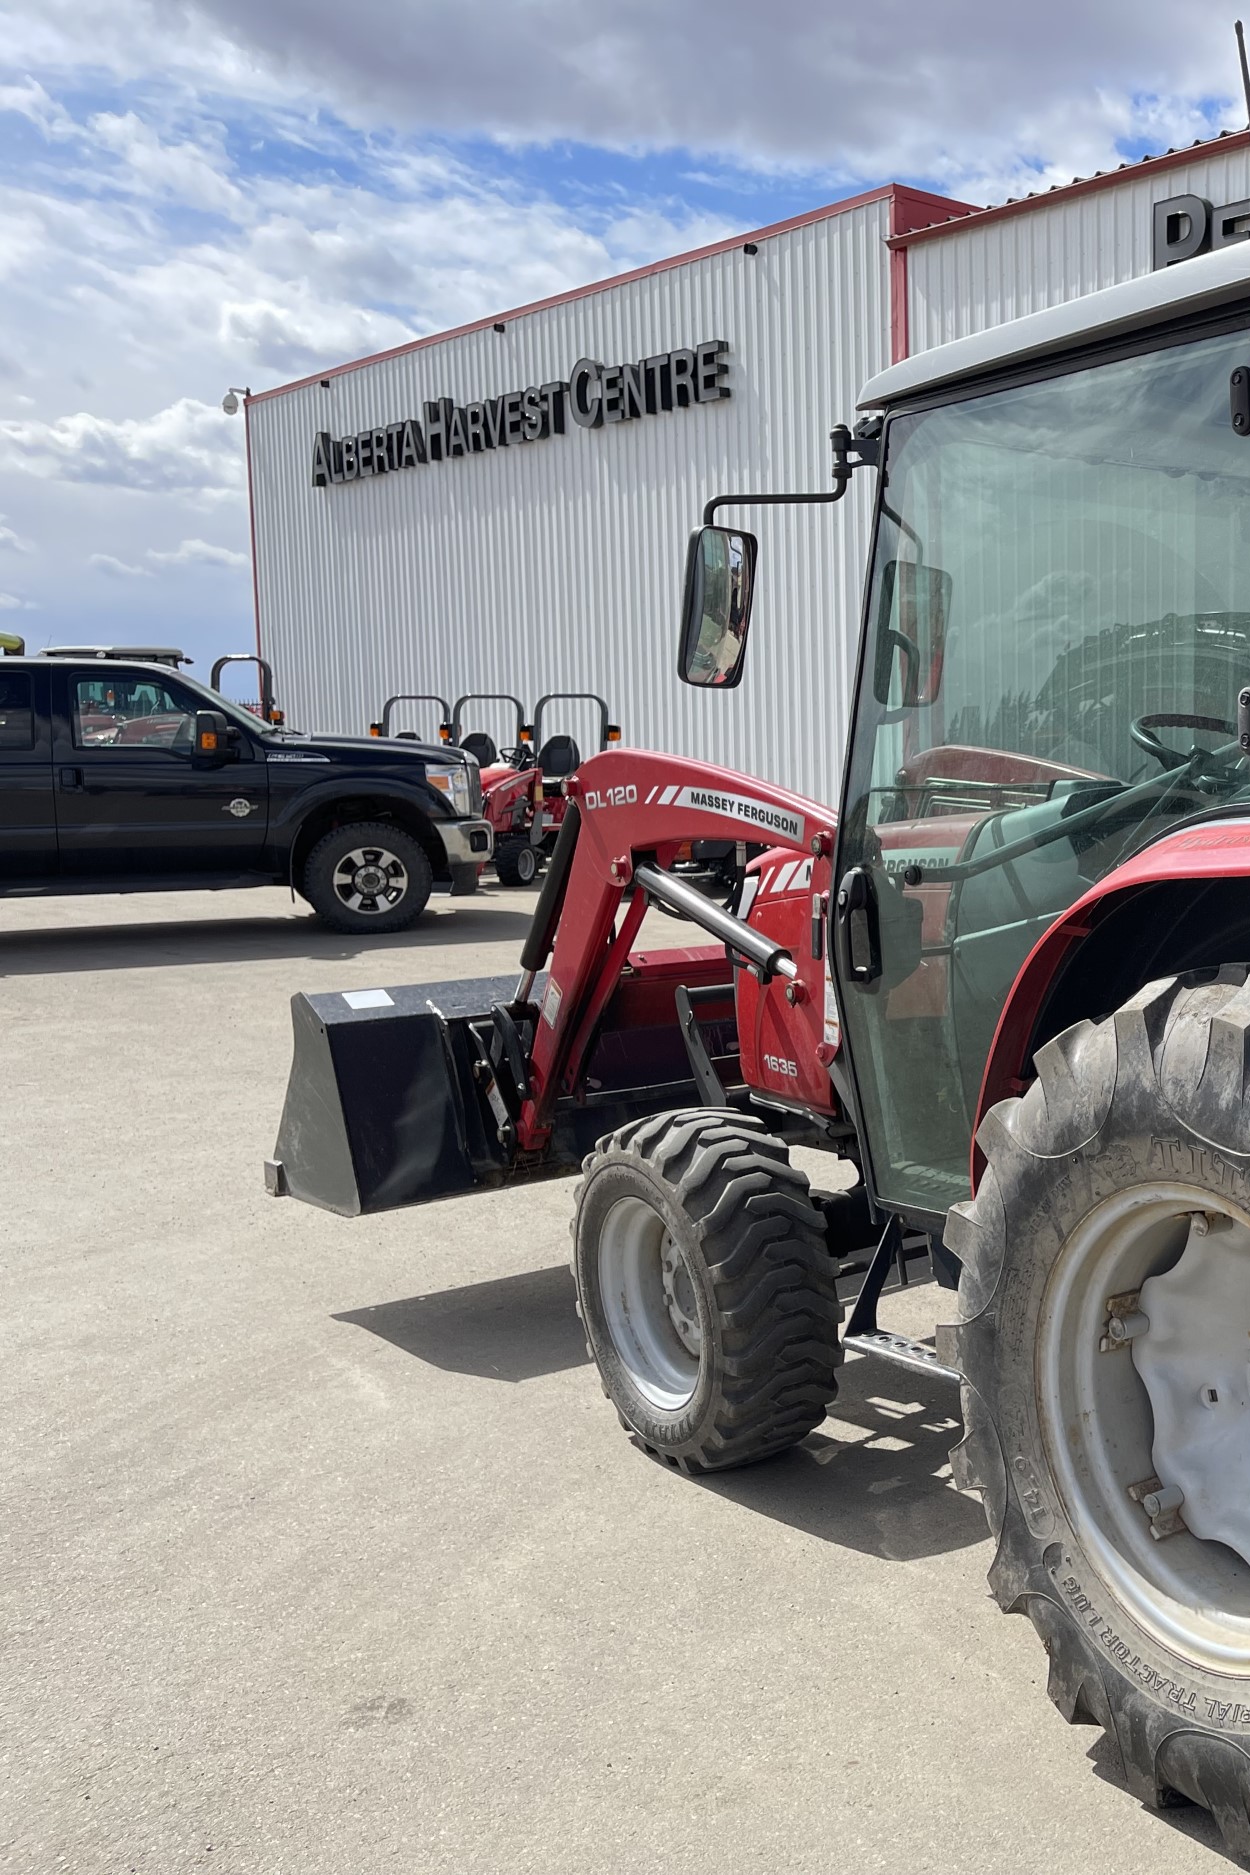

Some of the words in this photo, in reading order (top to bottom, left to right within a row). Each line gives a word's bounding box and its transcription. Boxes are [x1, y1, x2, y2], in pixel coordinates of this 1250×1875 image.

[312, 419, 428, 487] ALBERTA
[423, 380, 571, 463] HARVEST
[569, 339, 731, 429] CENTRE
[585, 784, 638, 810] DL120
[690, 791, 735, 812] MASSEY
[737, 802, 798, 836] FERGUSON
[763, 1053, 798, 1077] 1635
[1061, 1576, 1103, 1629] LUG
[1099, 1625, 1198, 1712] TRACTOR
